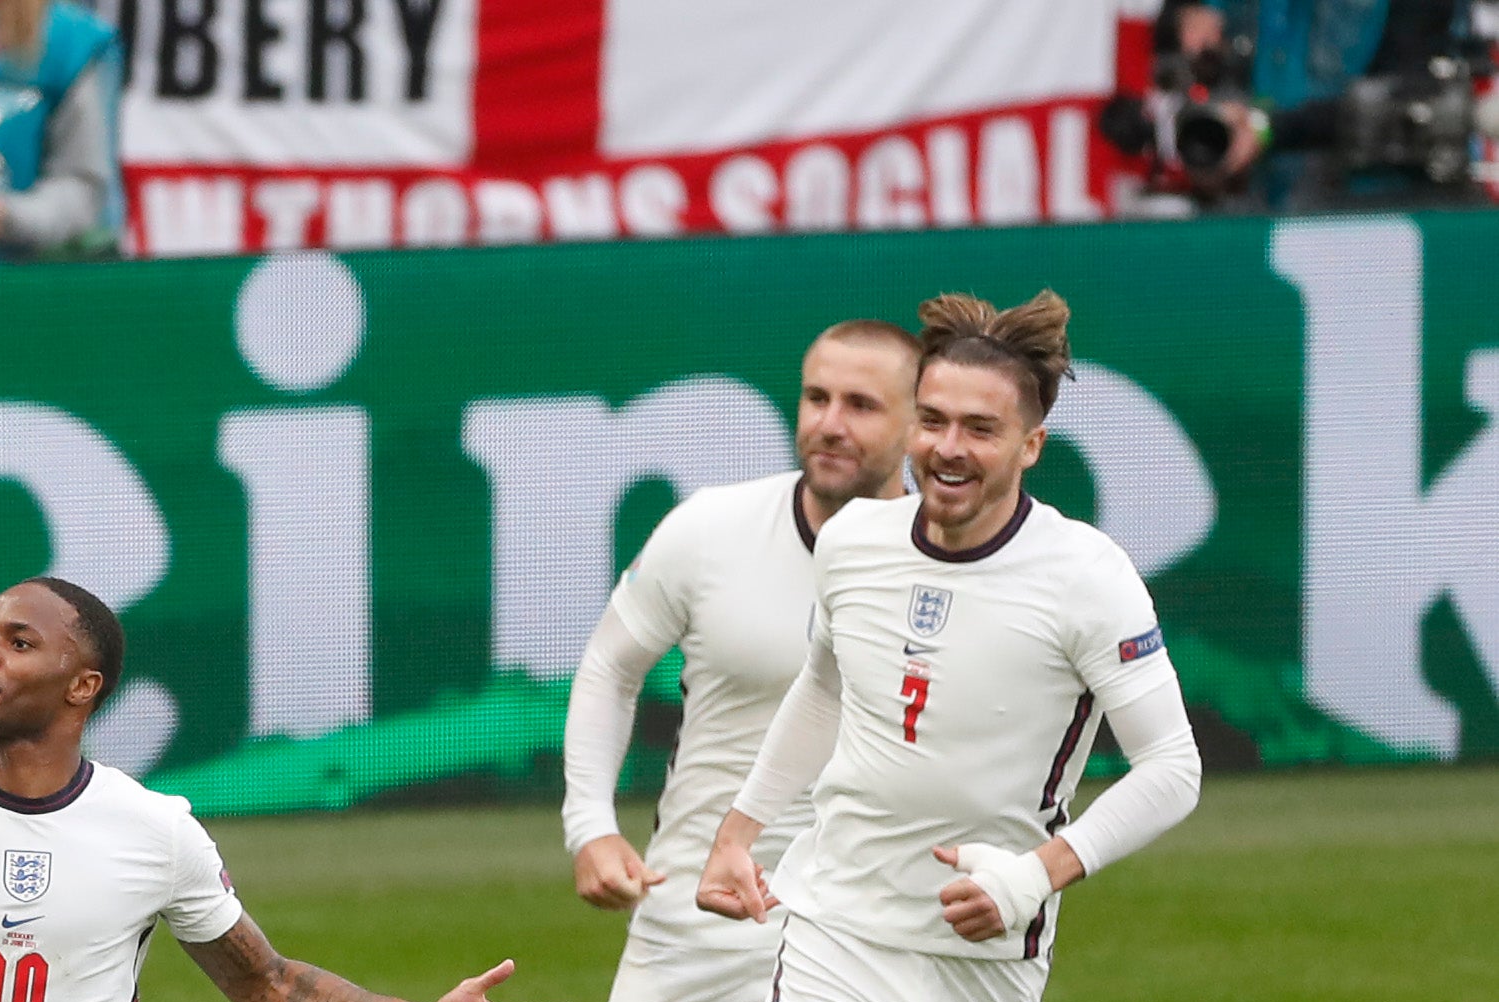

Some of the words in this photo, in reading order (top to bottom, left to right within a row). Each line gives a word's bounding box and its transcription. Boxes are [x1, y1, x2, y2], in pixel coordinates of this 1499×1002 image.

[118, 0, 445, 102] BERY
[708, 106, 1106, 238] SOCIAL
[901, 674, 930, 743] 7
